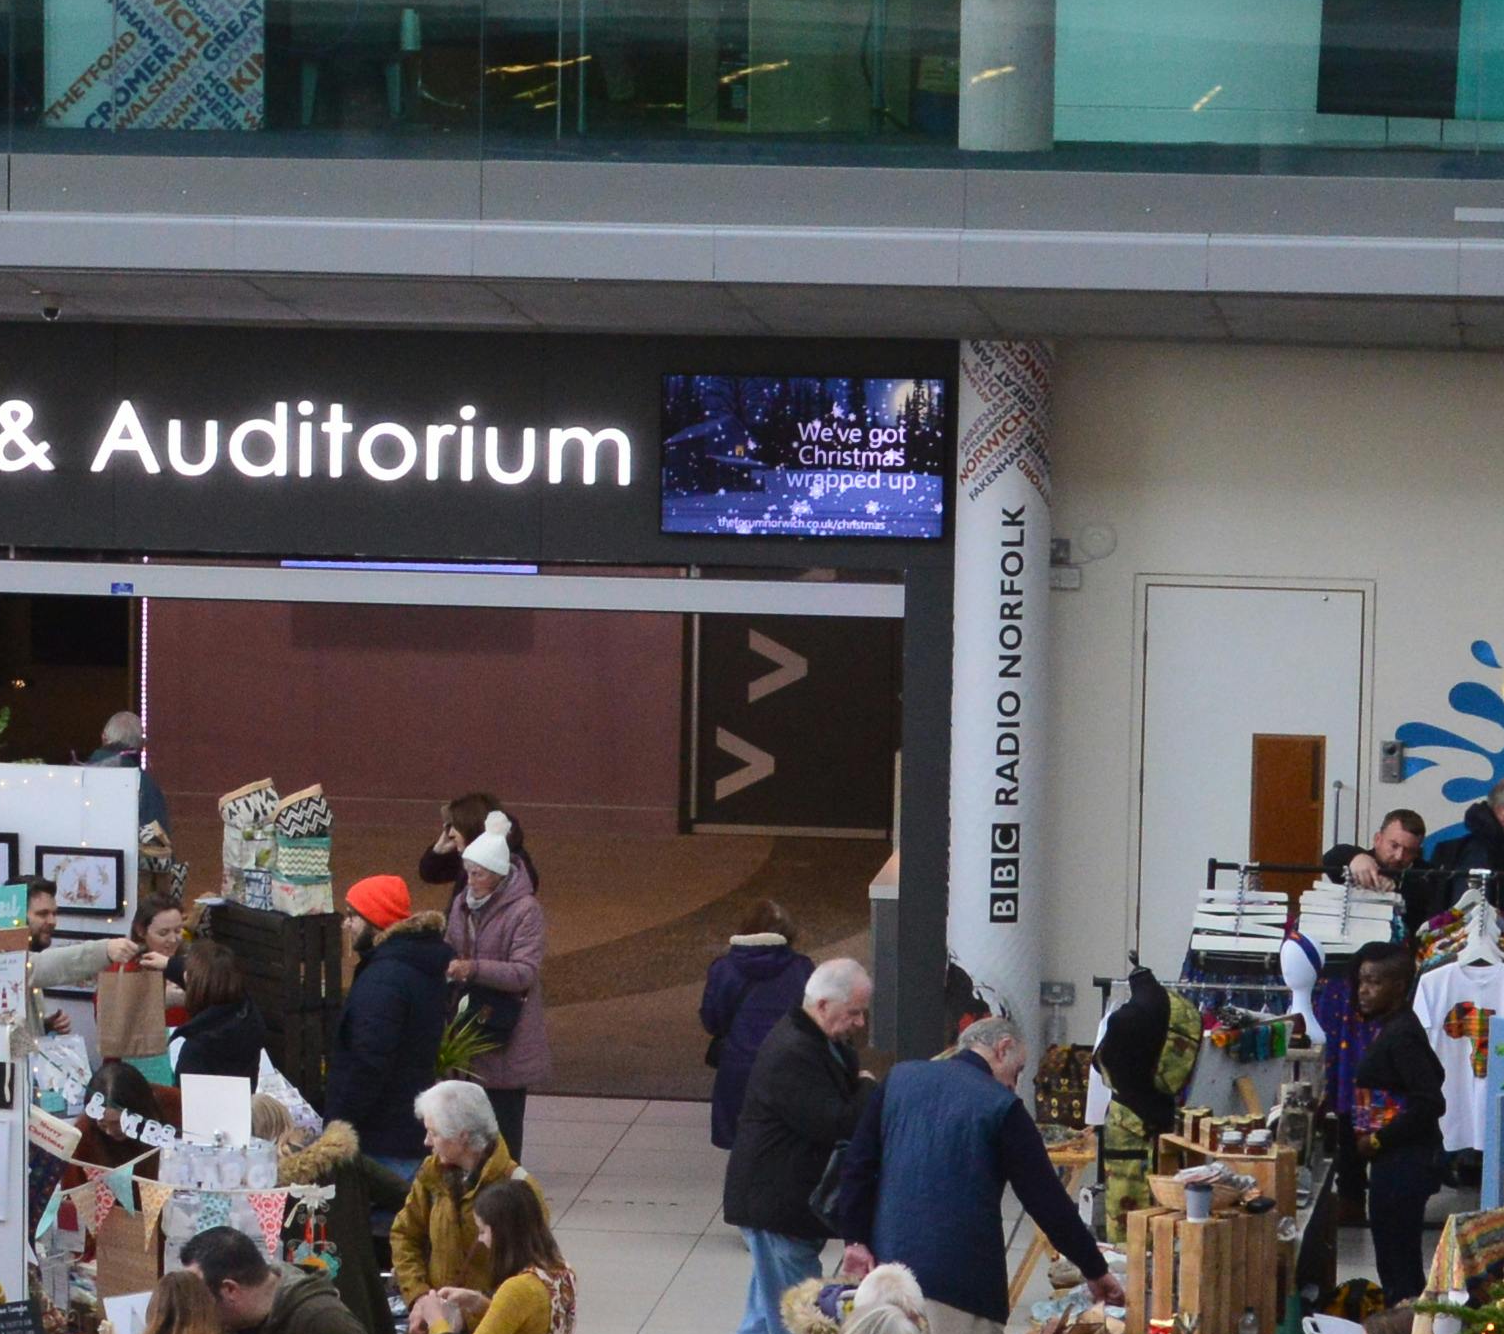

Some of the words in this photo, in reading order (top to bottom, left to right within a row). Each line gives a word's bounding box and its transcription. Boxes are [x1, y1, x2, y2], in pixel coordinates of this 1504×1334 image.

[44, 31, 137, 120] THETFORD
[85, 43, 176, 129] CROMER
[994, 371, 1036, 413] GREAT
[92, 399, 632, 486] Auditorium
[797, 422, 862, 442] We've
[868, 424, 907, 449] got
[798, 445, 906, 466] Christmas
[960, 407, 1028, 485] NORWICH
[969, 442, 1028, 501] FAKENHAM
[786, 471, 881, 494] wrapped
[889, 475, 917, 494] up
[717, 517, 886, 531] theforumnorwich.co.uk/christmas
[997, 505, 1027, 679] NORFOLK
[994, 691, 1020, 807] RADIO
[990, 824, 1020, 924] BBC
